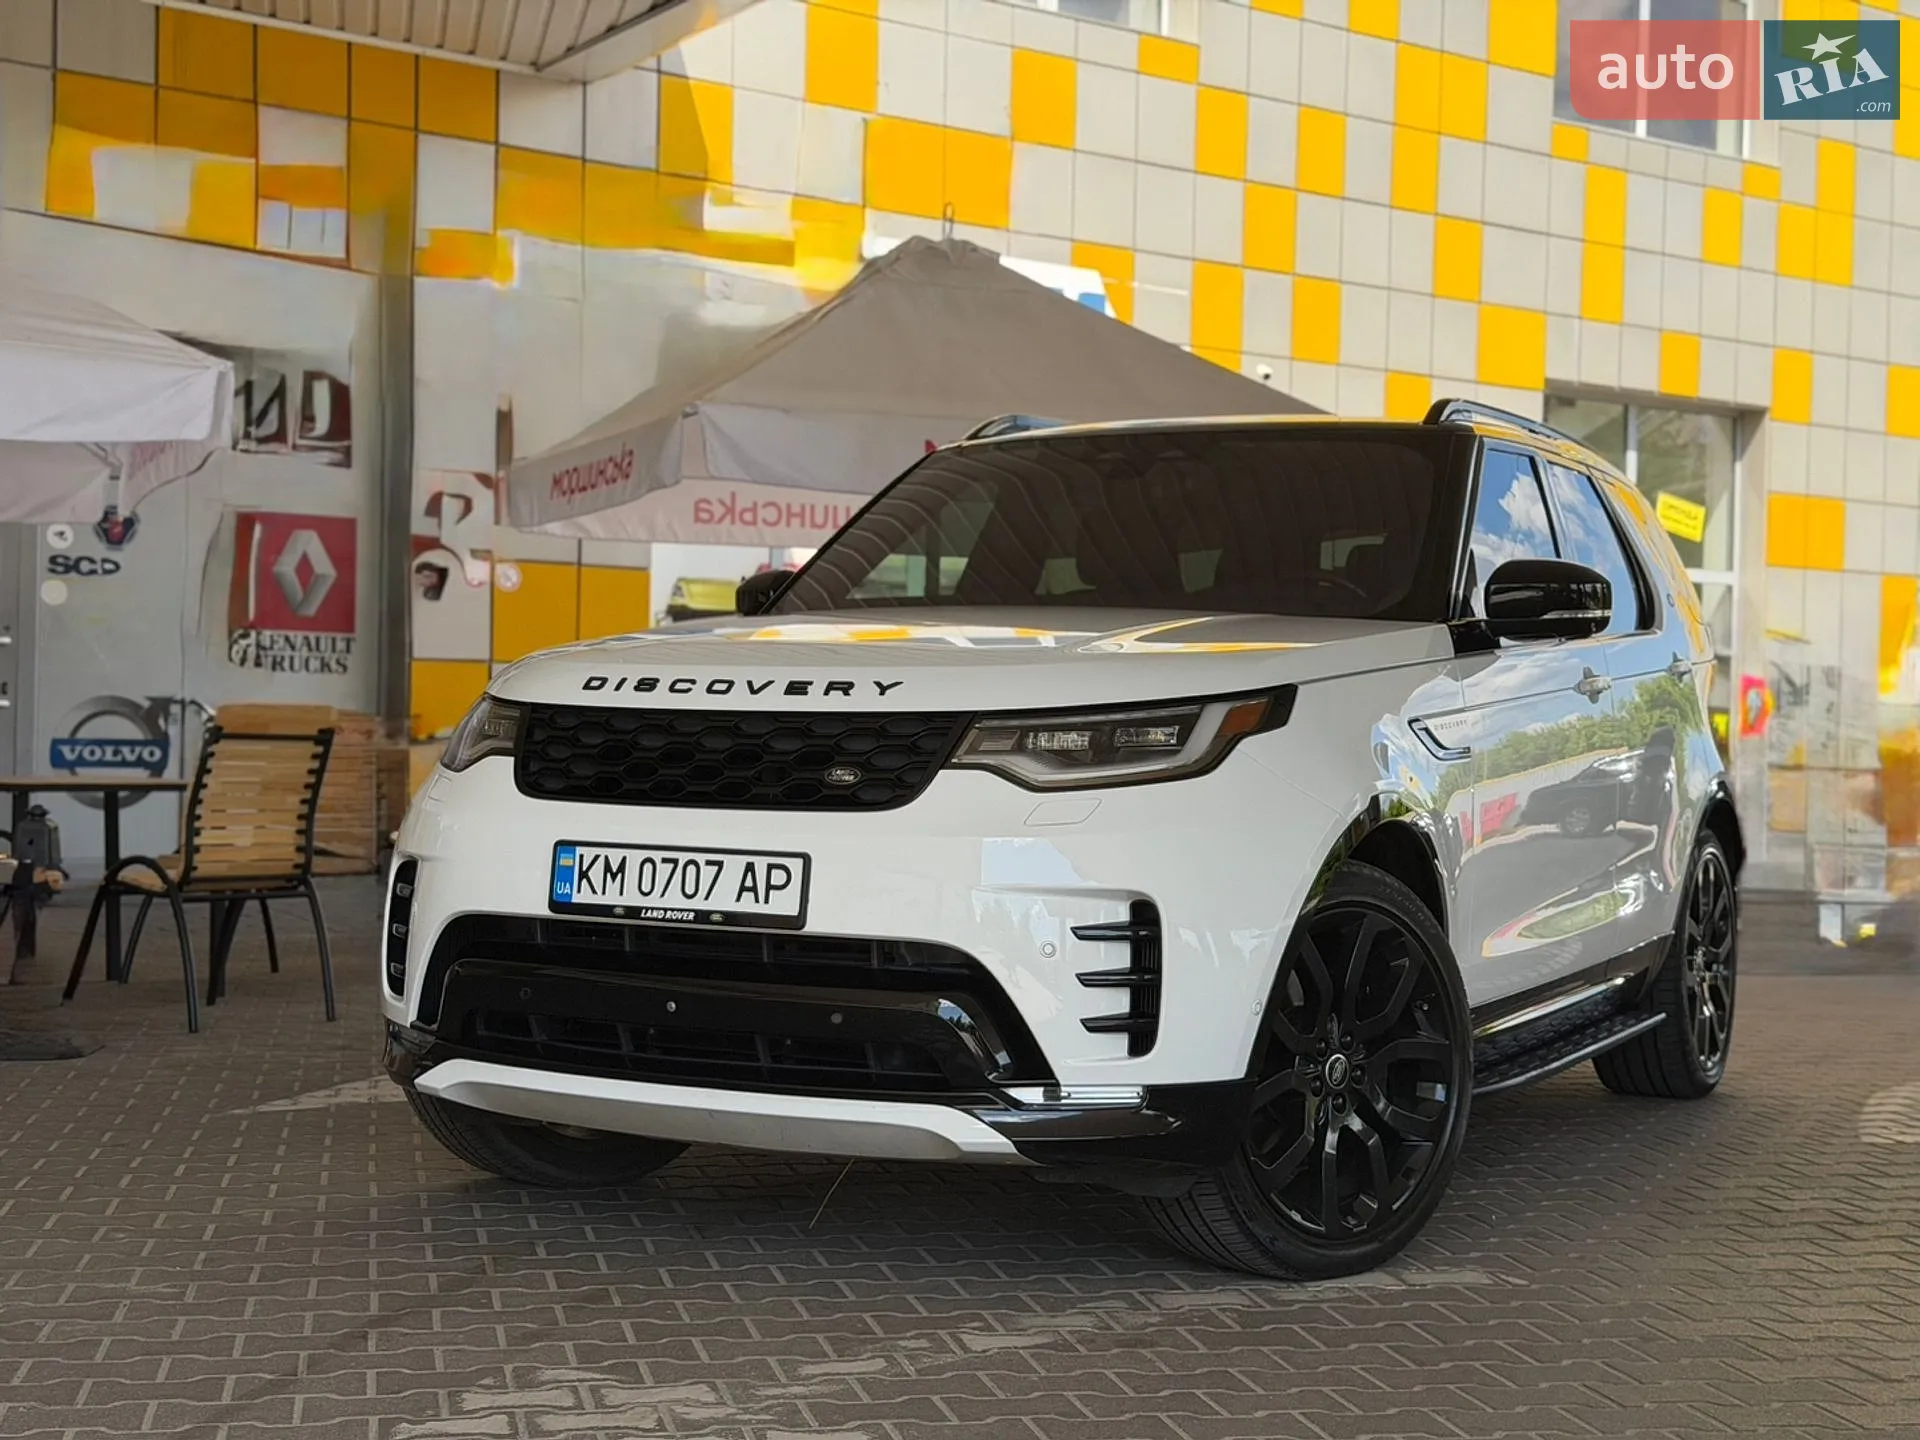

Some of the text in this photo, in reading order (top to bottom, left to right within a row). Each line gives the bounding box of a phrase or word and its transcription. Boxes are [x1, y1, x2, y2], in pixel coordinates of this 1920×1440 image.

[582, 676, 904, 696] DISCOVERY
[58, 745, 163, 763] VOLVO
[575, 853, 793, 904] KM 0707 AP
[556, 881, 572, 896] UA
[640, 908, 695, 921] LAND ROVER
